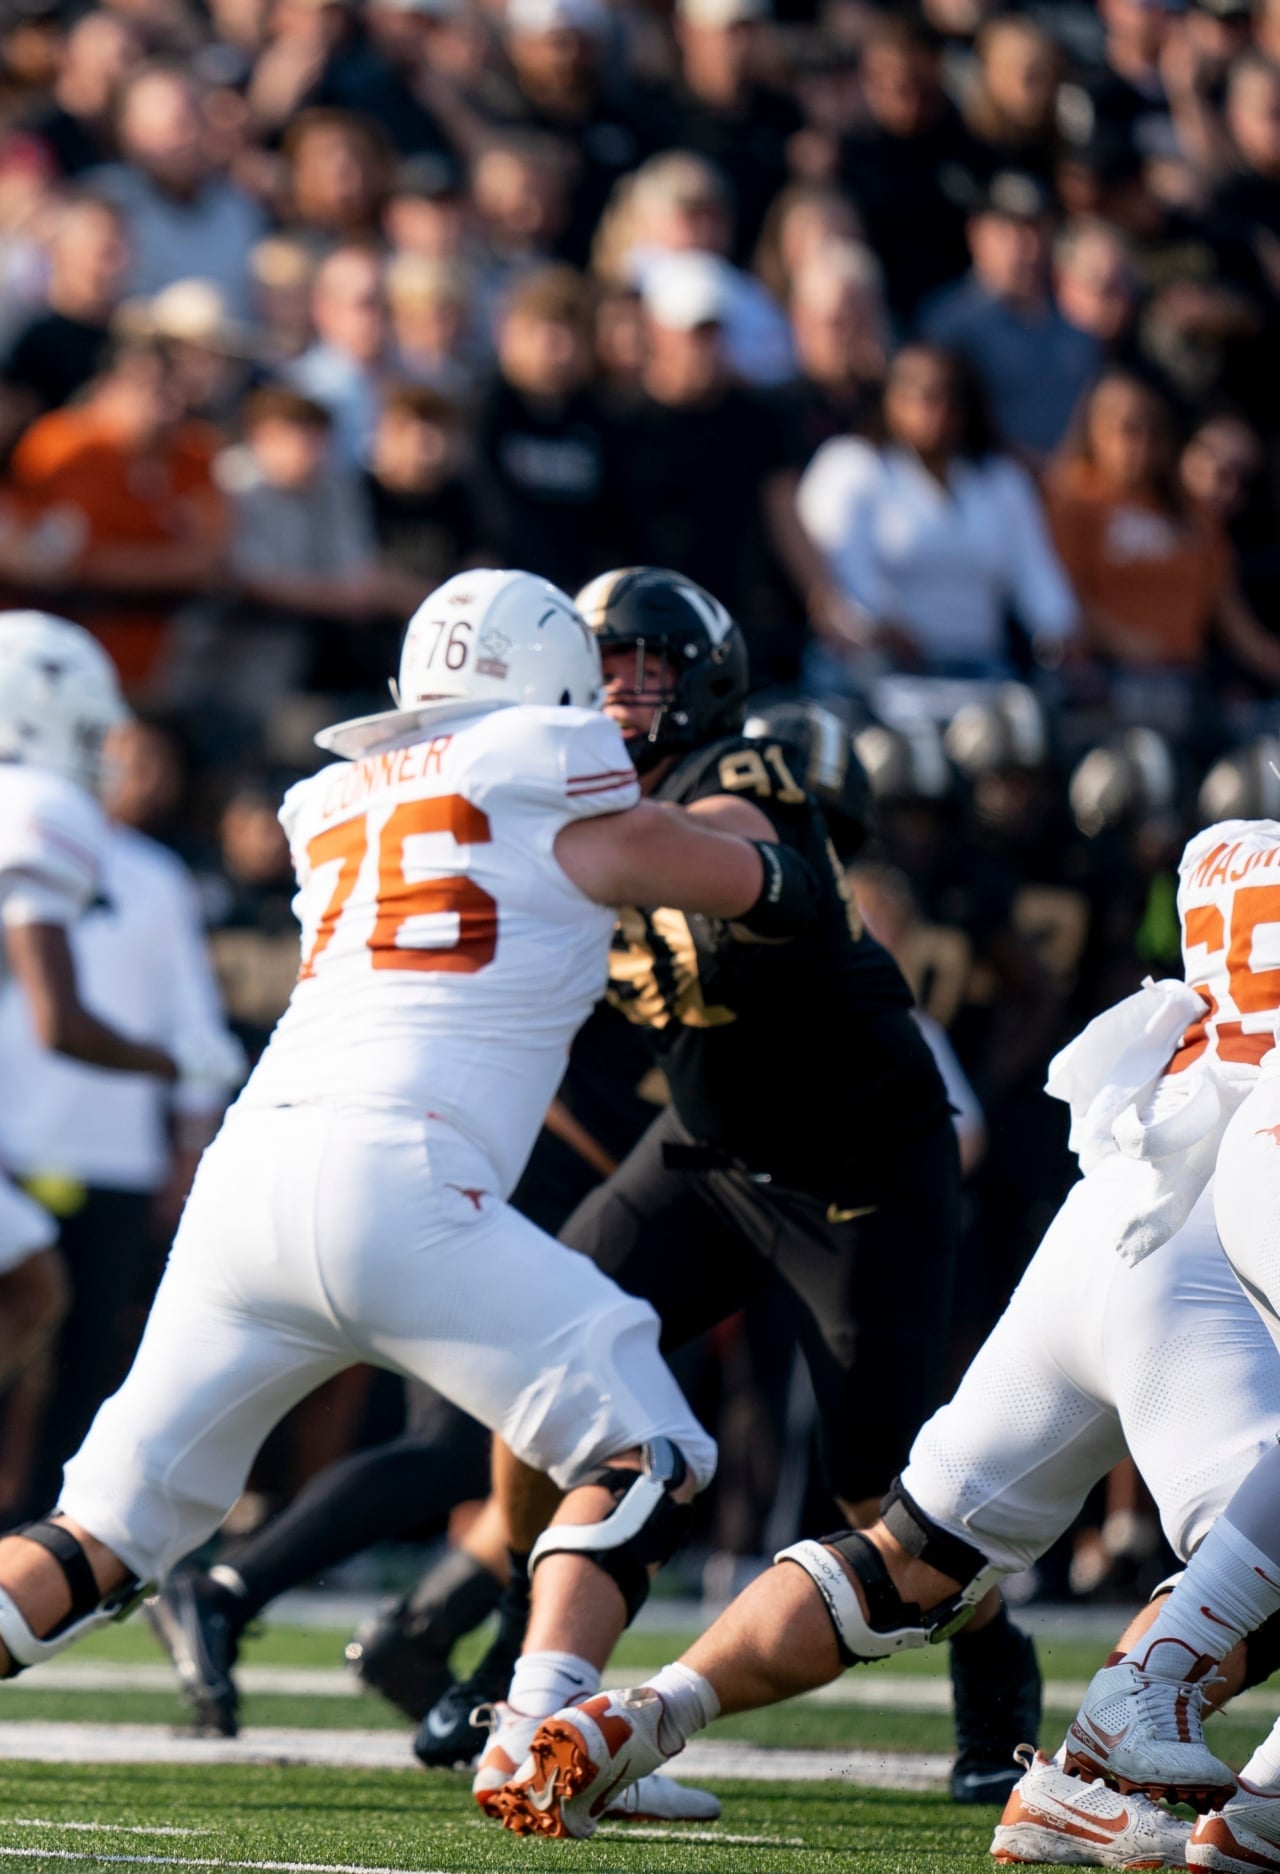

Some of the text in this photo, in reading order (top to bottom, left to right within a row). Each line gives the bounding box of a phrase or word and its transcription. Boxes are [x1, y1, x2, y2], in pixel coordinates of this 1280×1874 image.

[426, 620, 472, 670] 76
[719, 745, 806, 803] 91
[297, 793, 499, 981] 76
[1072, 1722, 1097, 1750] FORCE
[1020, 1802, 1068, 1830] FORCE
